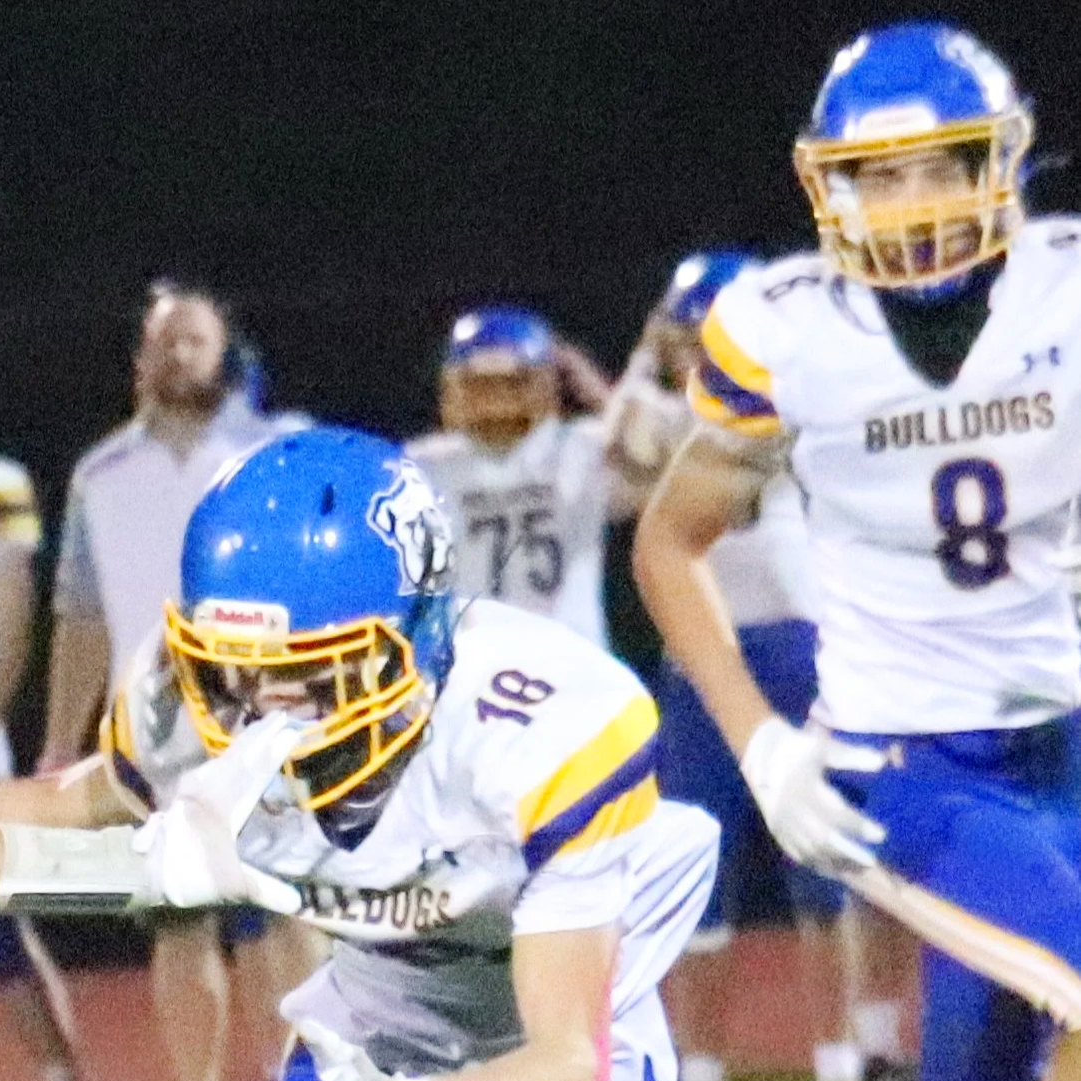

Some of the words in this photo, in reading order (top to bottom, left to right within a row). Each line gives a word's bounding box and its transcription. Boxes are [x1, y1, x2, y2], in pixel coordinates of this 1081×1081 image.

[865, 391, 1055, 452] BULLDOGS
[467, 508, 564, 597] 75
[932, 458, 1010, 588] 8
[475, 668, 556, 727] 18
